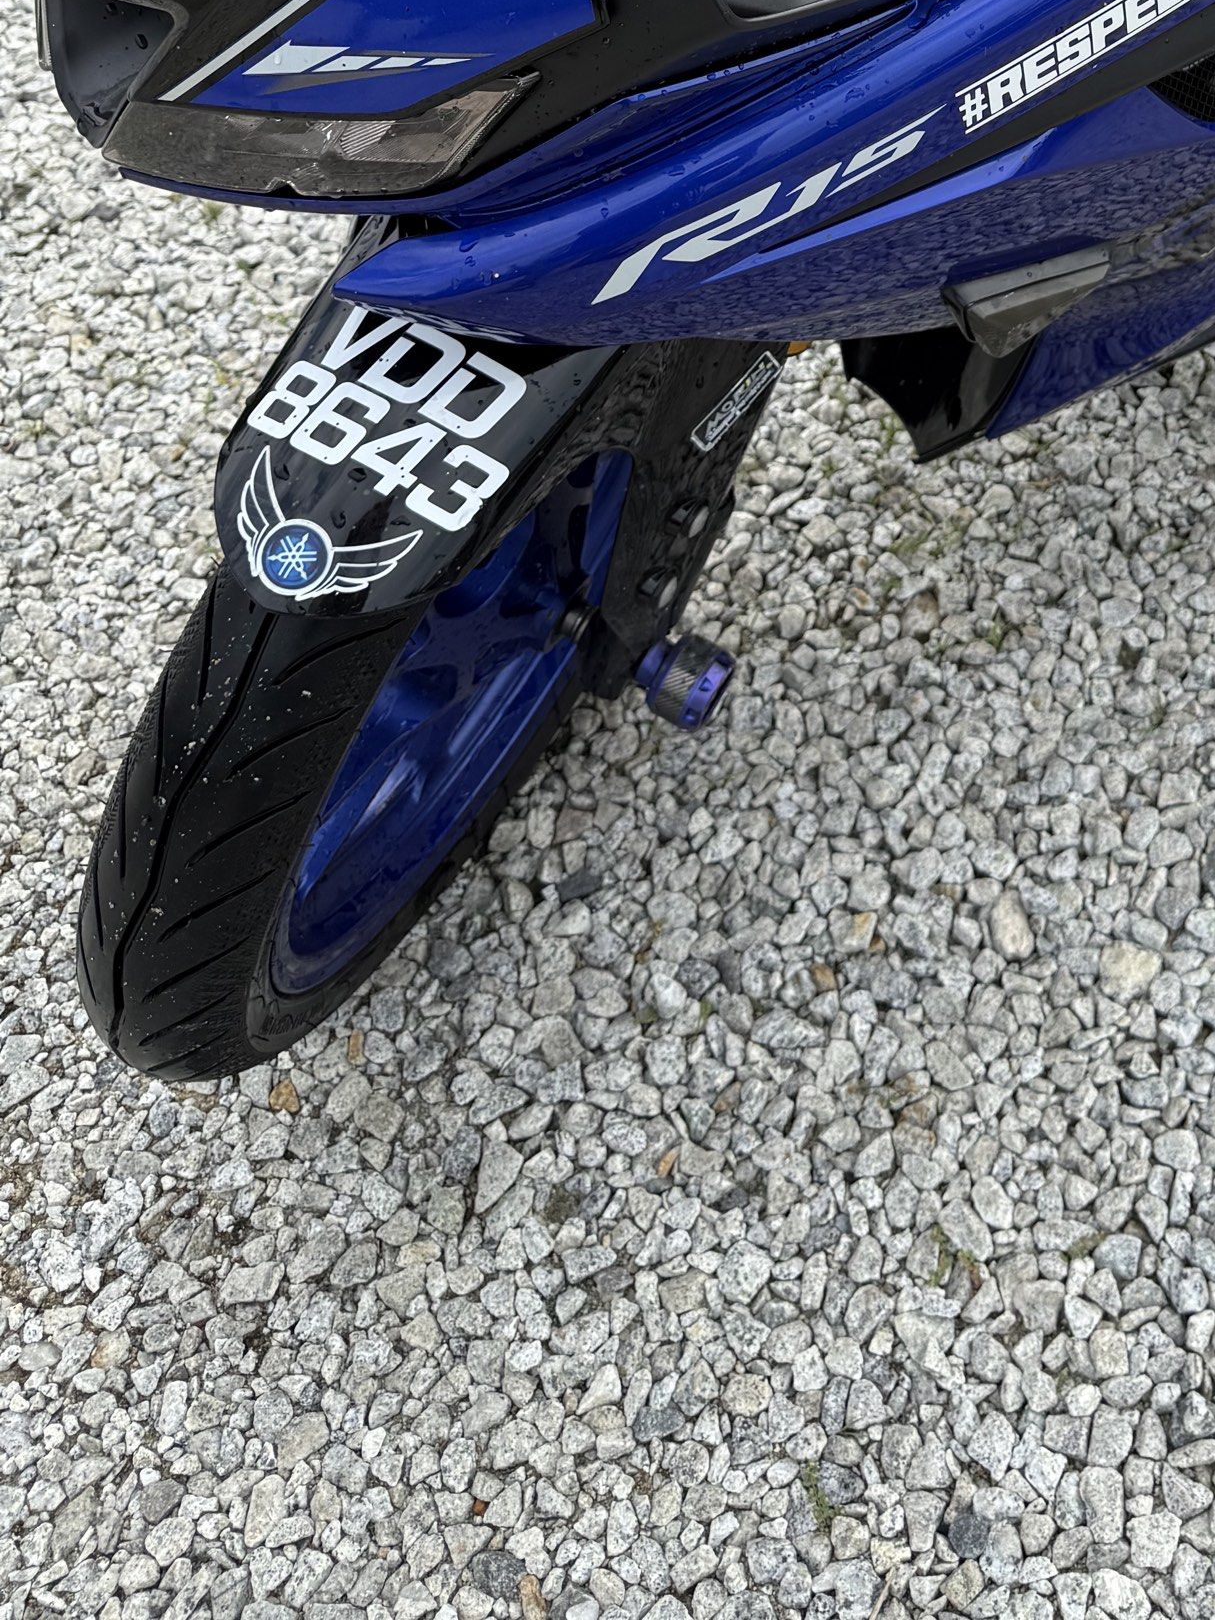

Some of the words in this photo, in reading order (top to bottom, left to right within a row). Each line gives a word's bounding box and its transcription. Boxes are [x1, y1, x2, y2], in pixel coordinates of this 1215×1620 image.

[591, 104, 947, 304] R15
[247, 360, 510, 532] 8643
[321, 306, 527, 439] VDD
